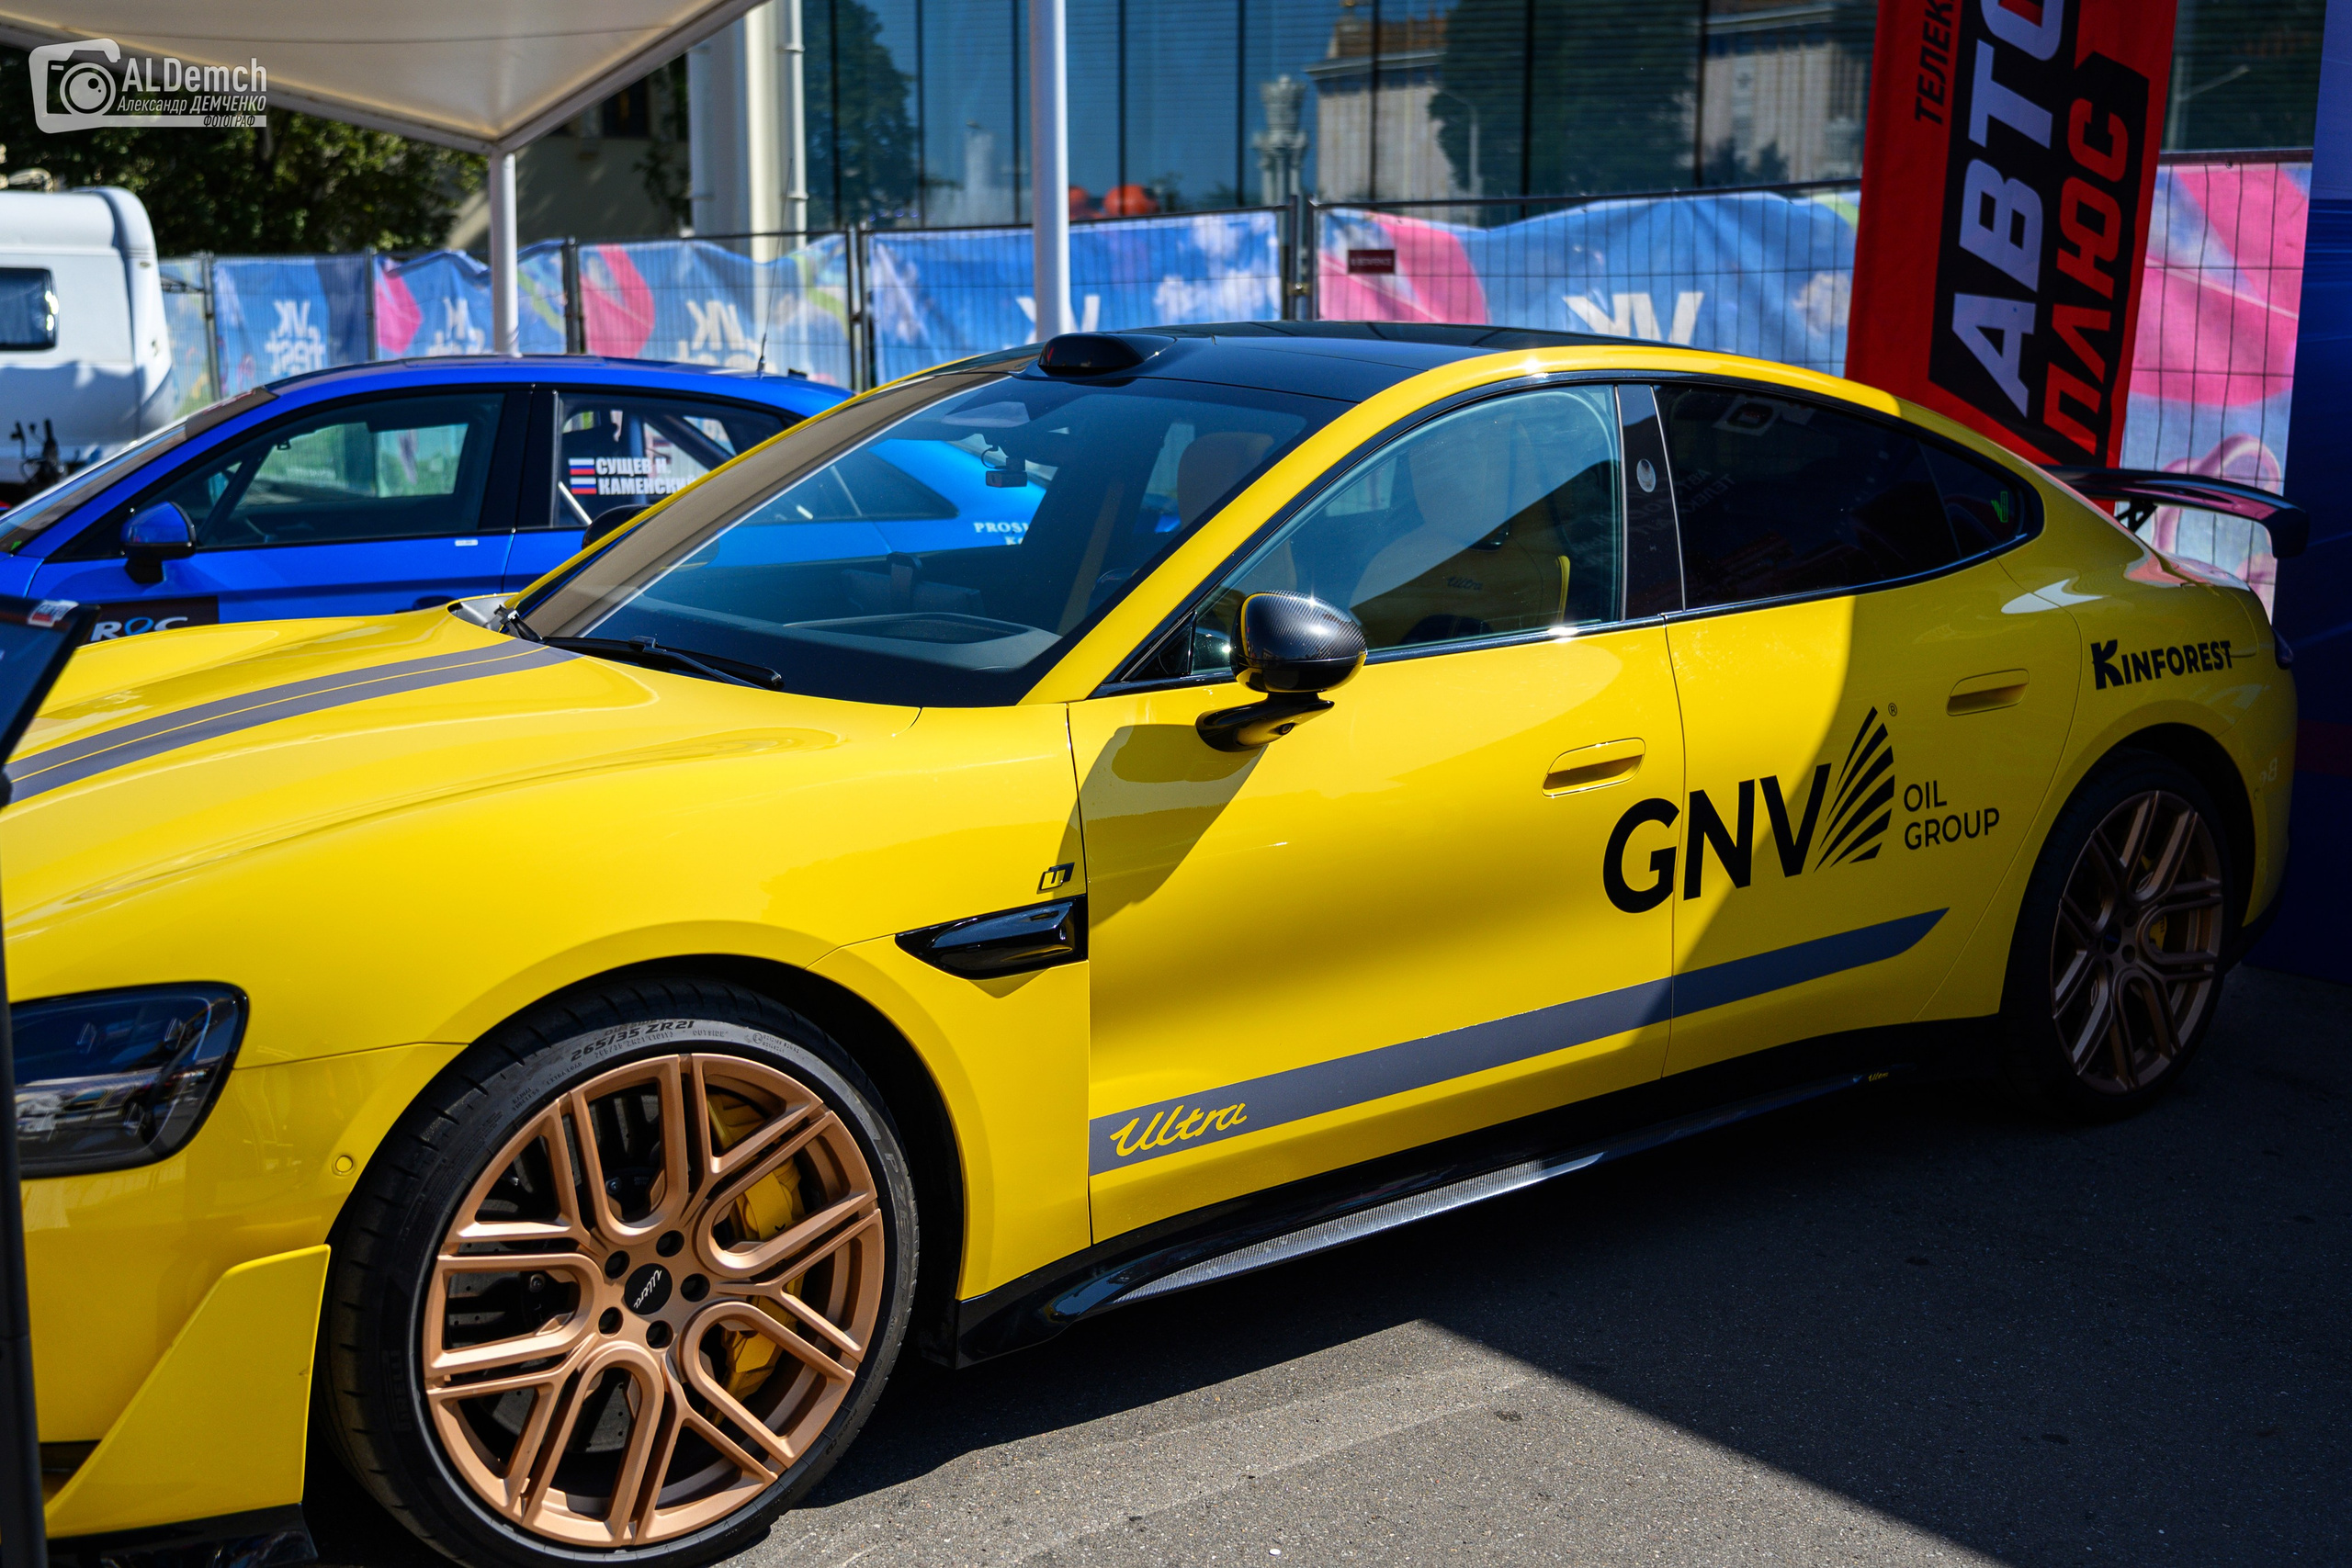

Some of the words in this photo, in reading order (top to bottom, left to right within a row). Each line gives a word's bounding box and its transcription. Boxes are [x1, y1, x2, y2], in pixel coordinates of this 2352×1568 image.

[1915, 0, 1955, 125] ТЕЛЕК
[1952, 0, 2064, 418] АВТО
[2043, 98, 2129, 456] ПЛЮС
[595, 457, 653, 477] СУЩЕВ
[2090, 638, 2233, 691] KINFOREST
[1903, 780, 1948, 813] OIL
[1602, 762, 1832, 914] GNV
[1904, 807, 2000, 850] GROUP
[571, 1027, 641, 1062] 265/35
[1110, 1102, 1248, 1157] Ultra
[633, 1269, 662, 1309] Ultra
